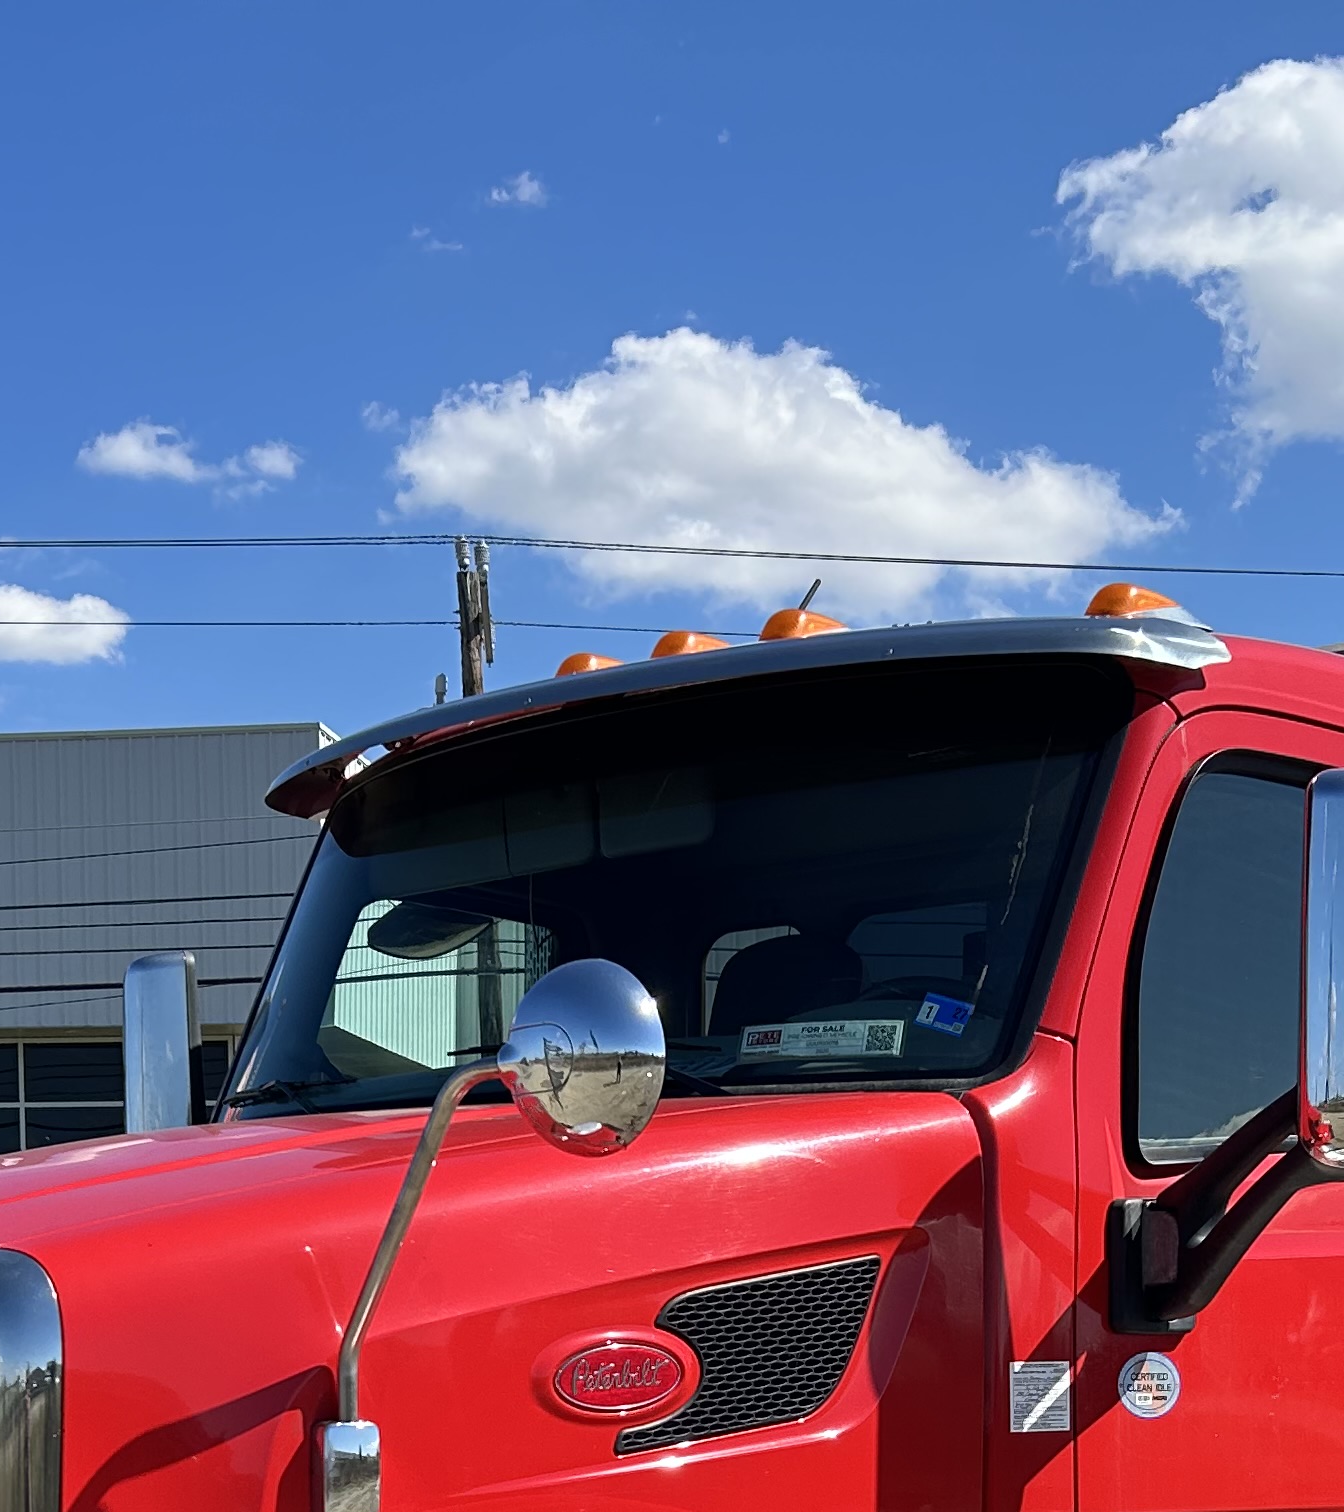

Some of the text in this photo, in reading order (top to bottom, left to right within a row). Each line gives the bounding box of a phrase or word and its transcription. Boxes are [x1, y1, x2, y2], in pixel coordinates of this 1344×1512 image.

[800, 1024, 846, 1034] FOR SALE
[571, 1357, 671, 1396] Peterbilt
[1130, 1372, 1169, 1382] CERTIFIED
[1126, 1383, 1172, 1393] CLEAN IDLE
